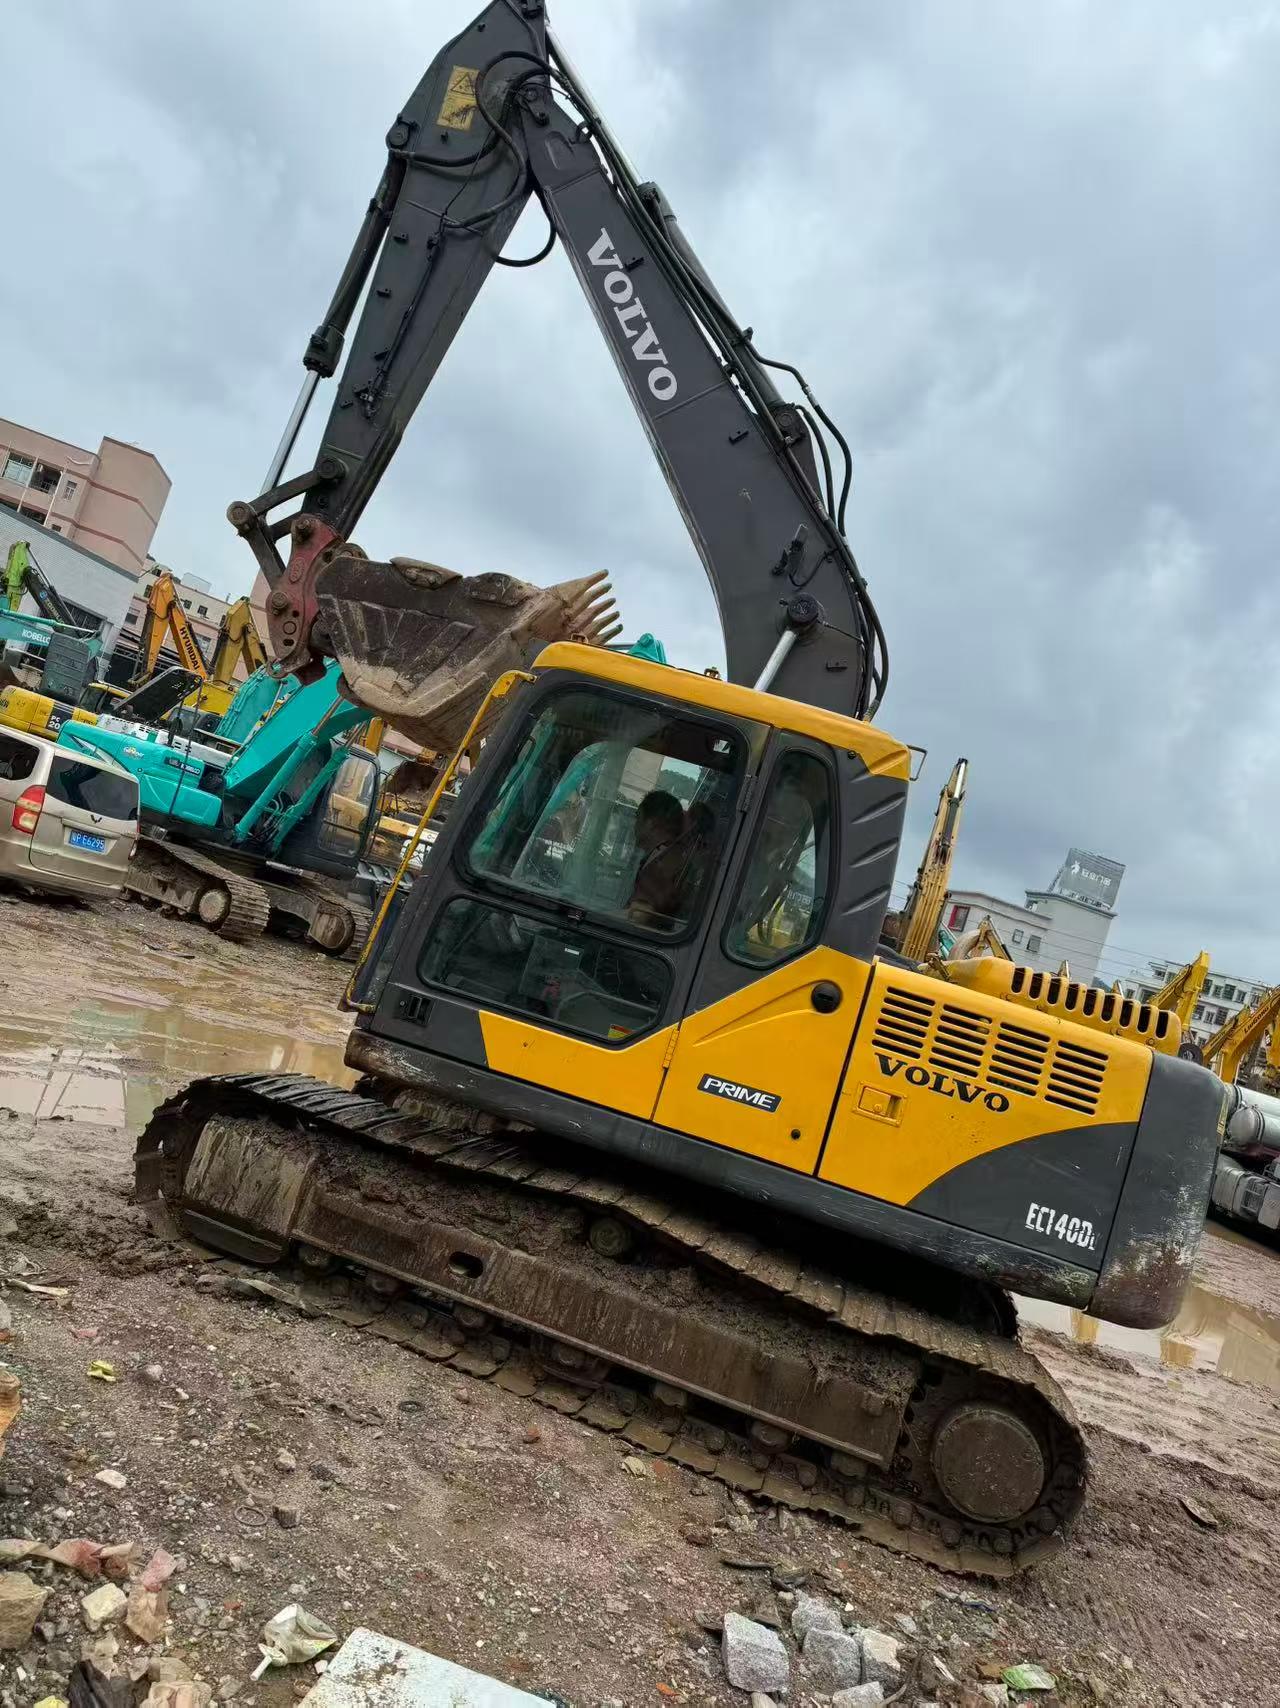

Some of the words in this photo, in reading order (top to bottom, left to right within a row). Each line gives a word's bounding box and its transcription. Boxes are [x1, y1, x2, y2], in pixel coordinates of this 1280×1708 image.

[587, 227, 677, 400] VOLVO
[21, 628, 51, 644] KOBELC
[180, 627, 200, 670] HYUNDAI
[48, 721, 61, 730] 20
[703, 1077, 776, 1109] PRIME
[874, 1052, 1010, 1113] VOLVO
